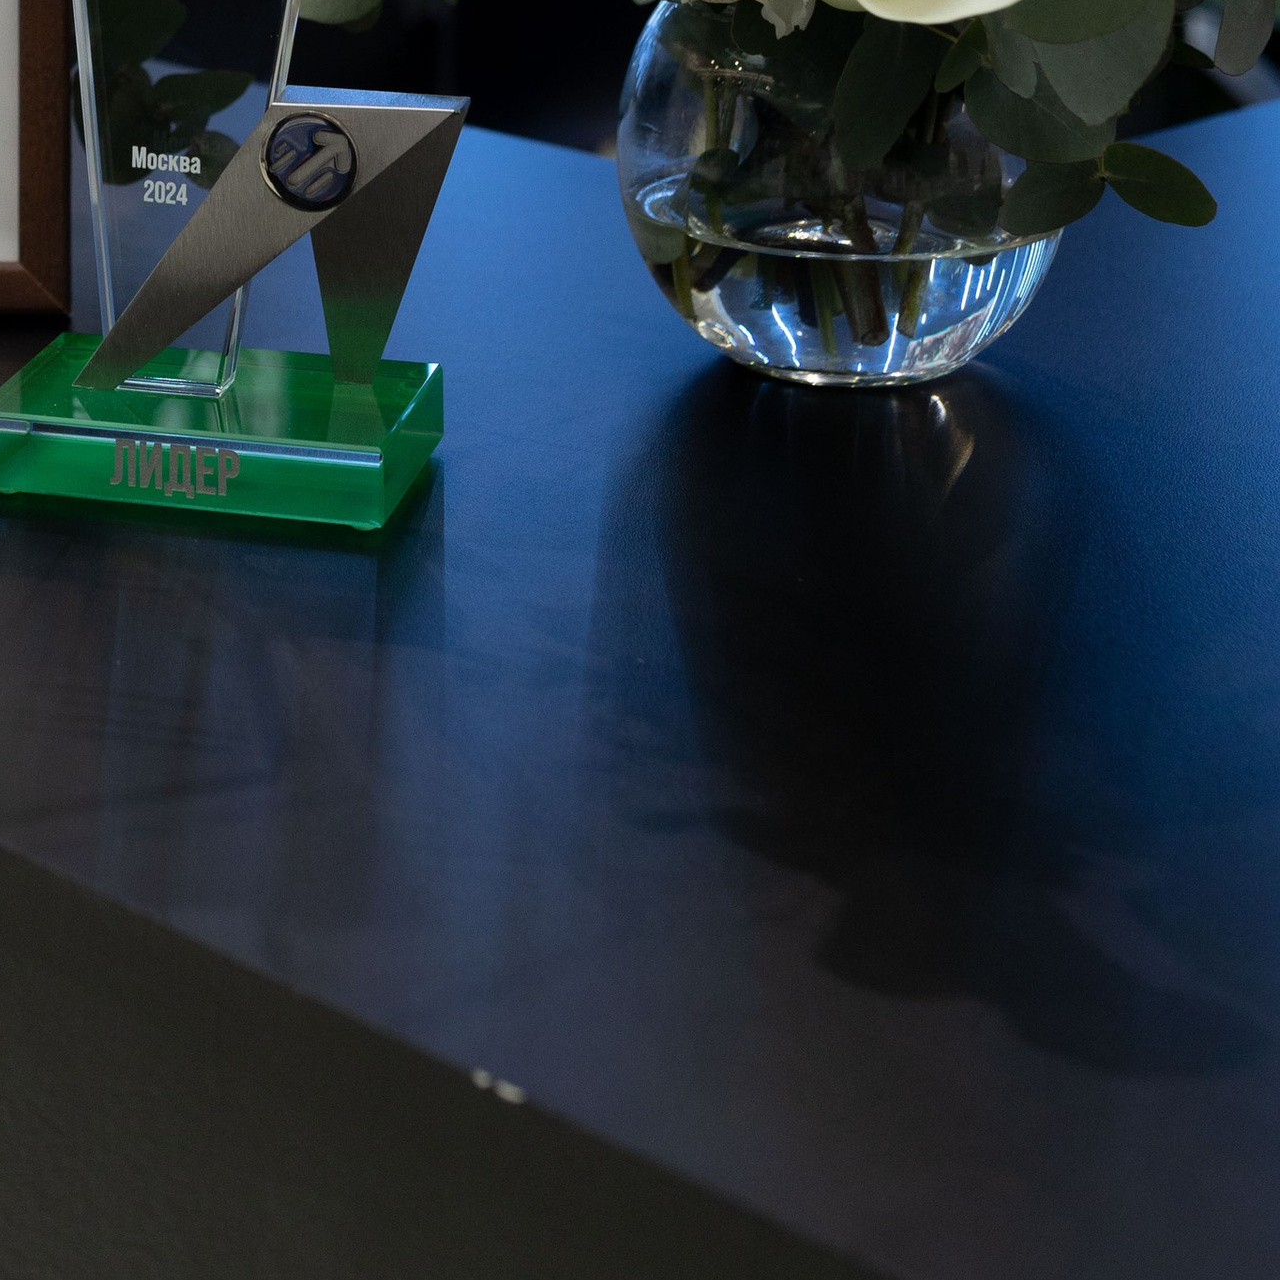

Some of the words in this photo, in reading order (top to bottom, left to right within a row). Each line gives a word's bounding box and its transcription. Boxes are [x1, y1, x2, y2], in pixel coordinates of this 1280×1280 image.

[131, 146, 201, 174] Москва
[143, 180, 188, 206] 2024
[110, 439, 240, 499] ЛИДЕР
